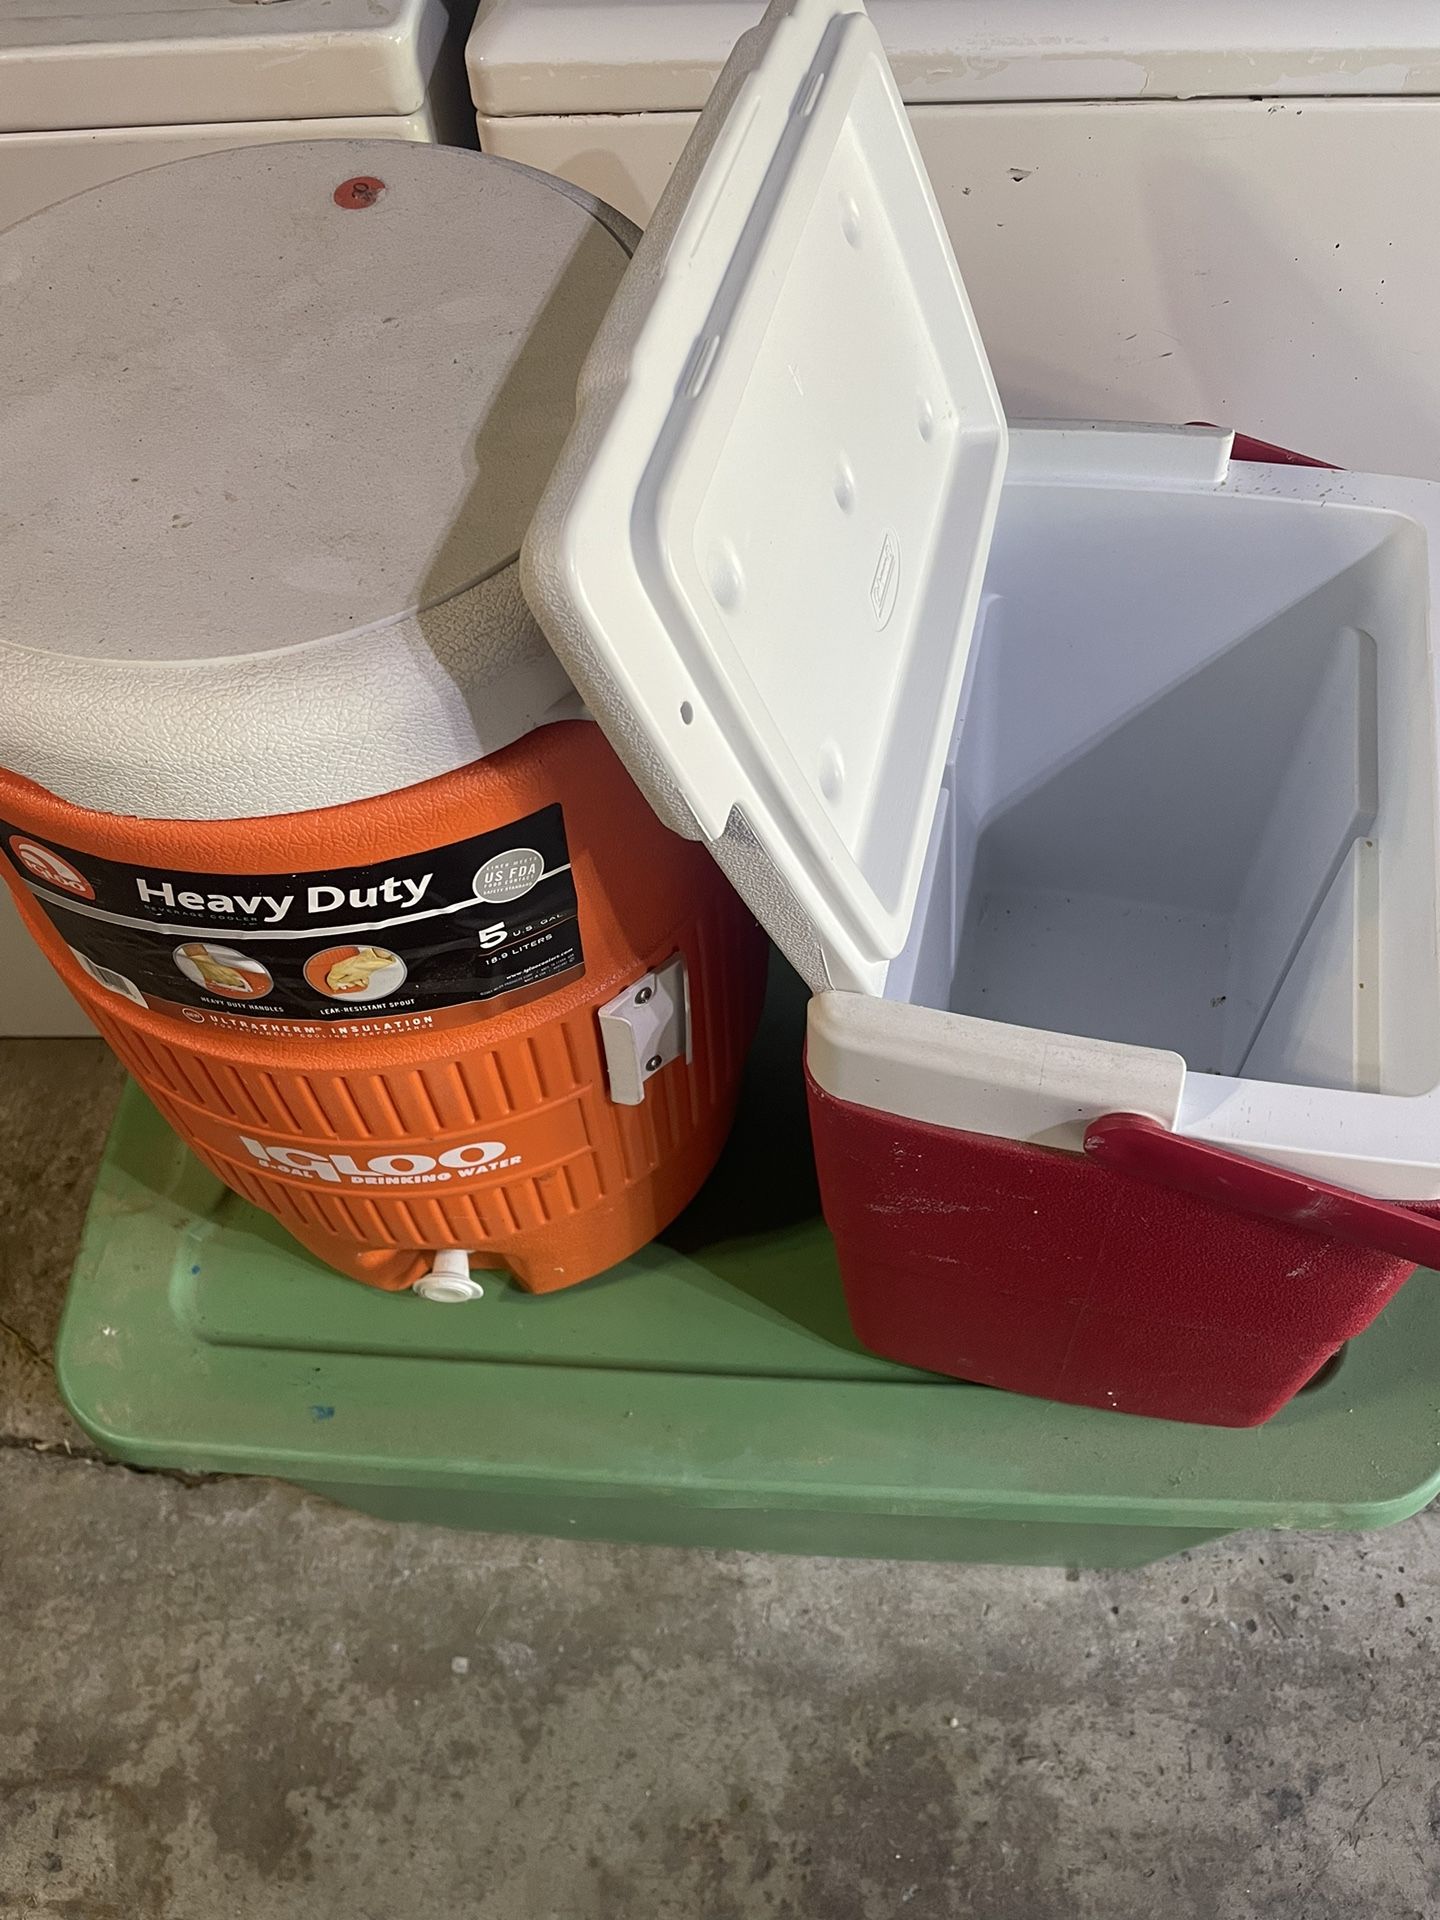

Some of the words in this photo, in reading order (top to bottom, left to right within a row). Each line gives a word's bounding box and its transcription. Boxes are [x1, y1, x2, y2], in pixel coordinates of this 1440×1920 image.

[484, 870, 503, 883] US
[509, 863, 536, 879] FDA
[136, 878, 295, 922] Heavy
[307, 873, 433, 914] Duty
[210, 914, 258, 922] COOLER
[478, 921, 508, 949] 5
[511, 933, 553, 955] LITERS
[200, 996, 224, 1006] HEAVY
[226, 1001, 247, 1009] DUTY
[248, 1004, 284, 1013] HANDLES
[320, 1003, 386, 1015] LEAK-RESISTANT
[389, 998, 415, 1008] SPOUT
[331, 1016, 433, 1035] INSULATION
[351, 1172, 452, 1185] DRINKING
[457, 1155, 522, 1178] WATER
